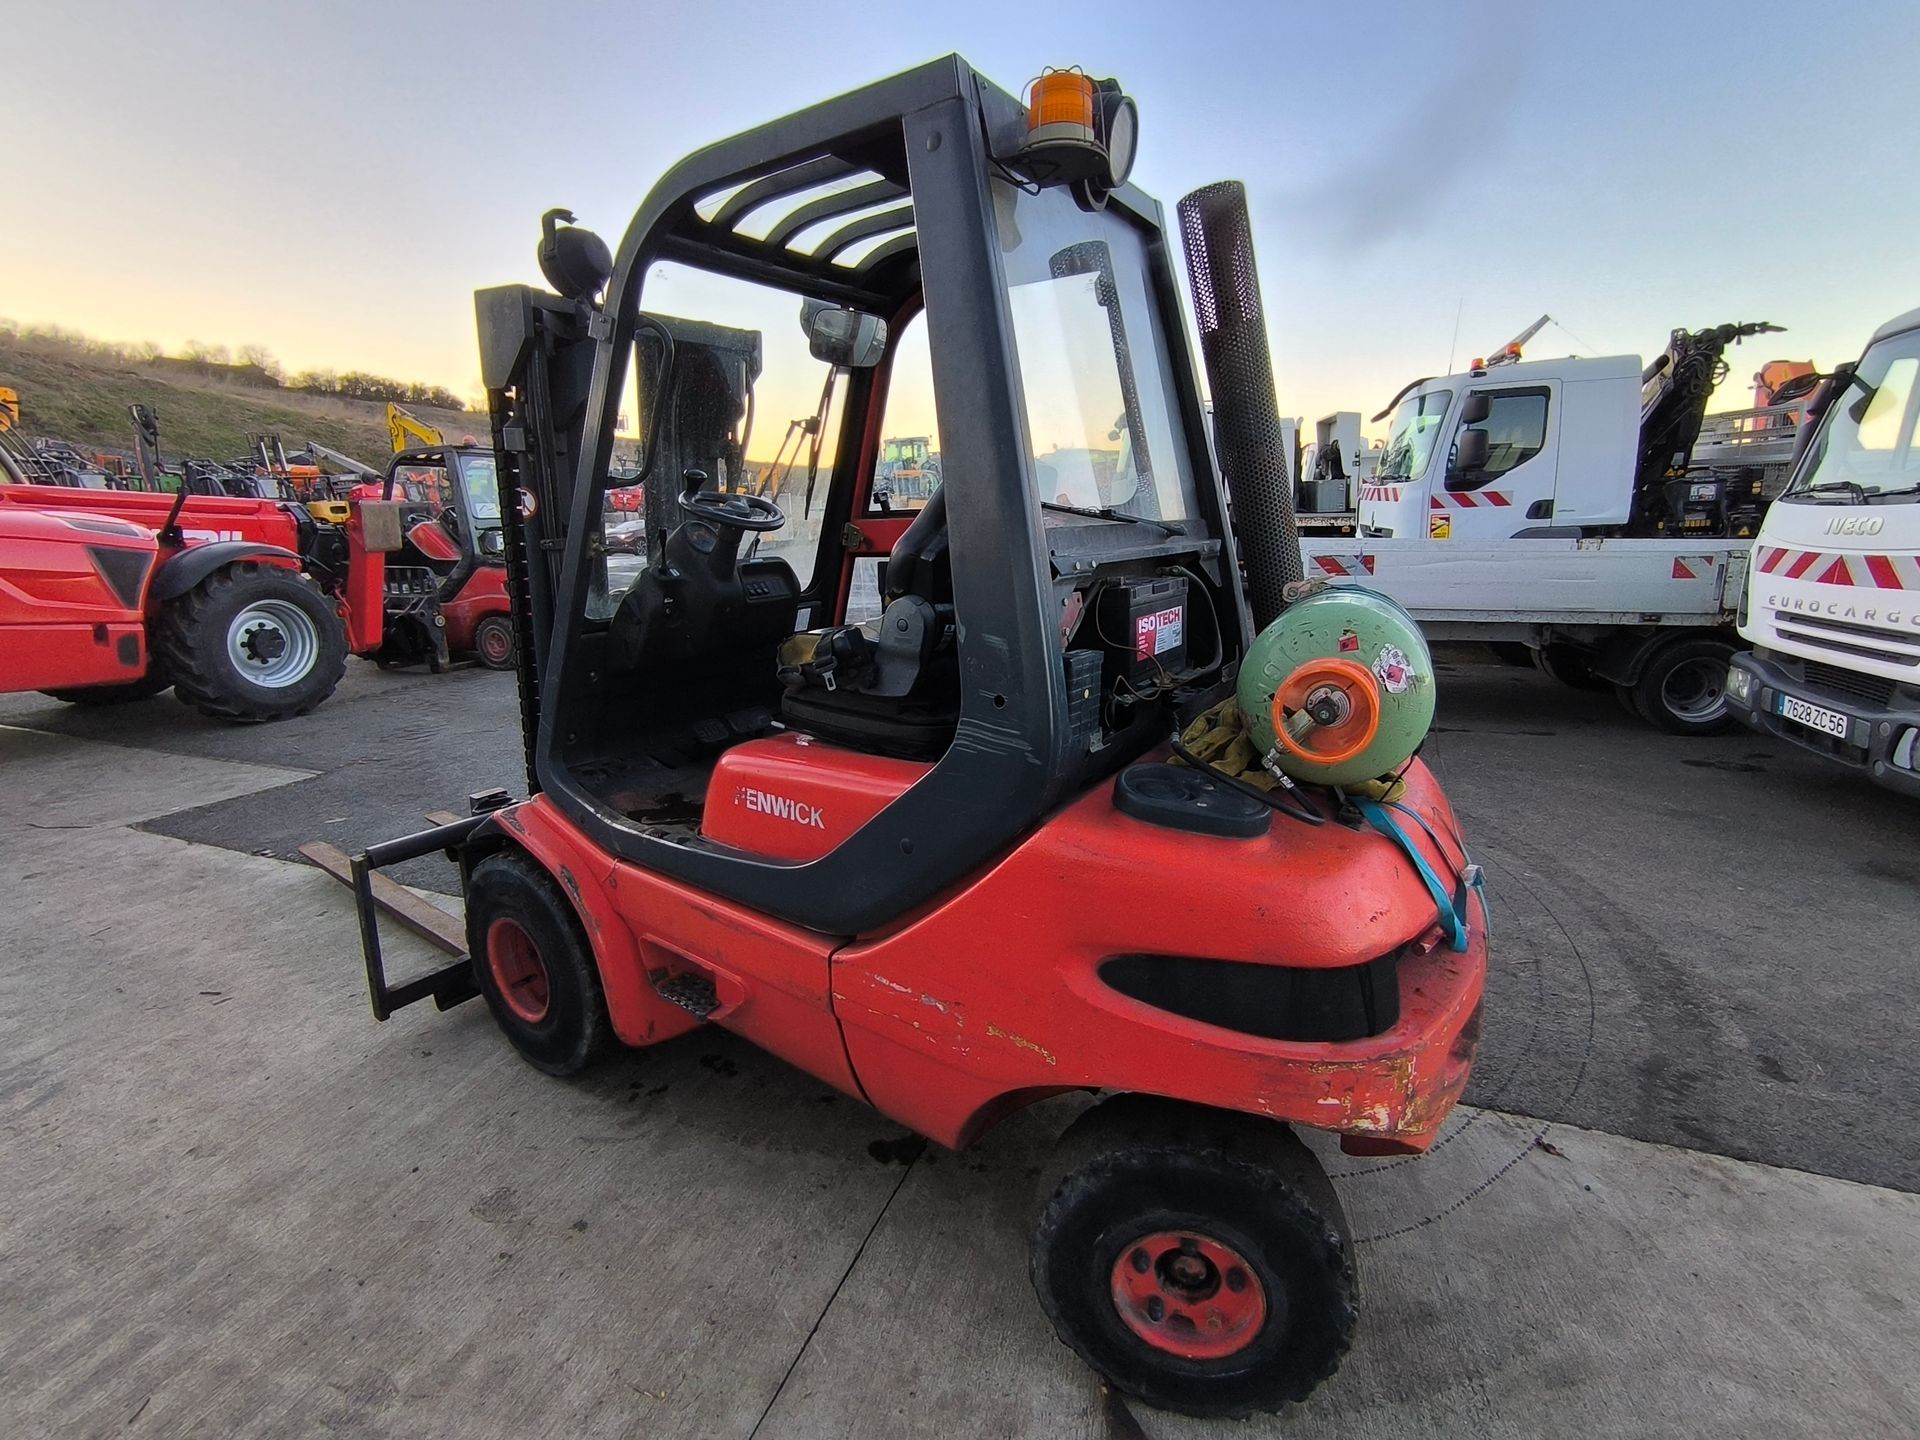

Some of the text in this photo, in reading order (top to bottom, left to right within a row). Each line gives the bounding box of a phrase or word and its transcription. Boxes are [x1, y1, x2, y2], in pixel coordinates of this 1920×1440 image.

[1823, 517, 1885, 536] IVECO
[1787, 699, 1845, 735] 7628 ZC 56
